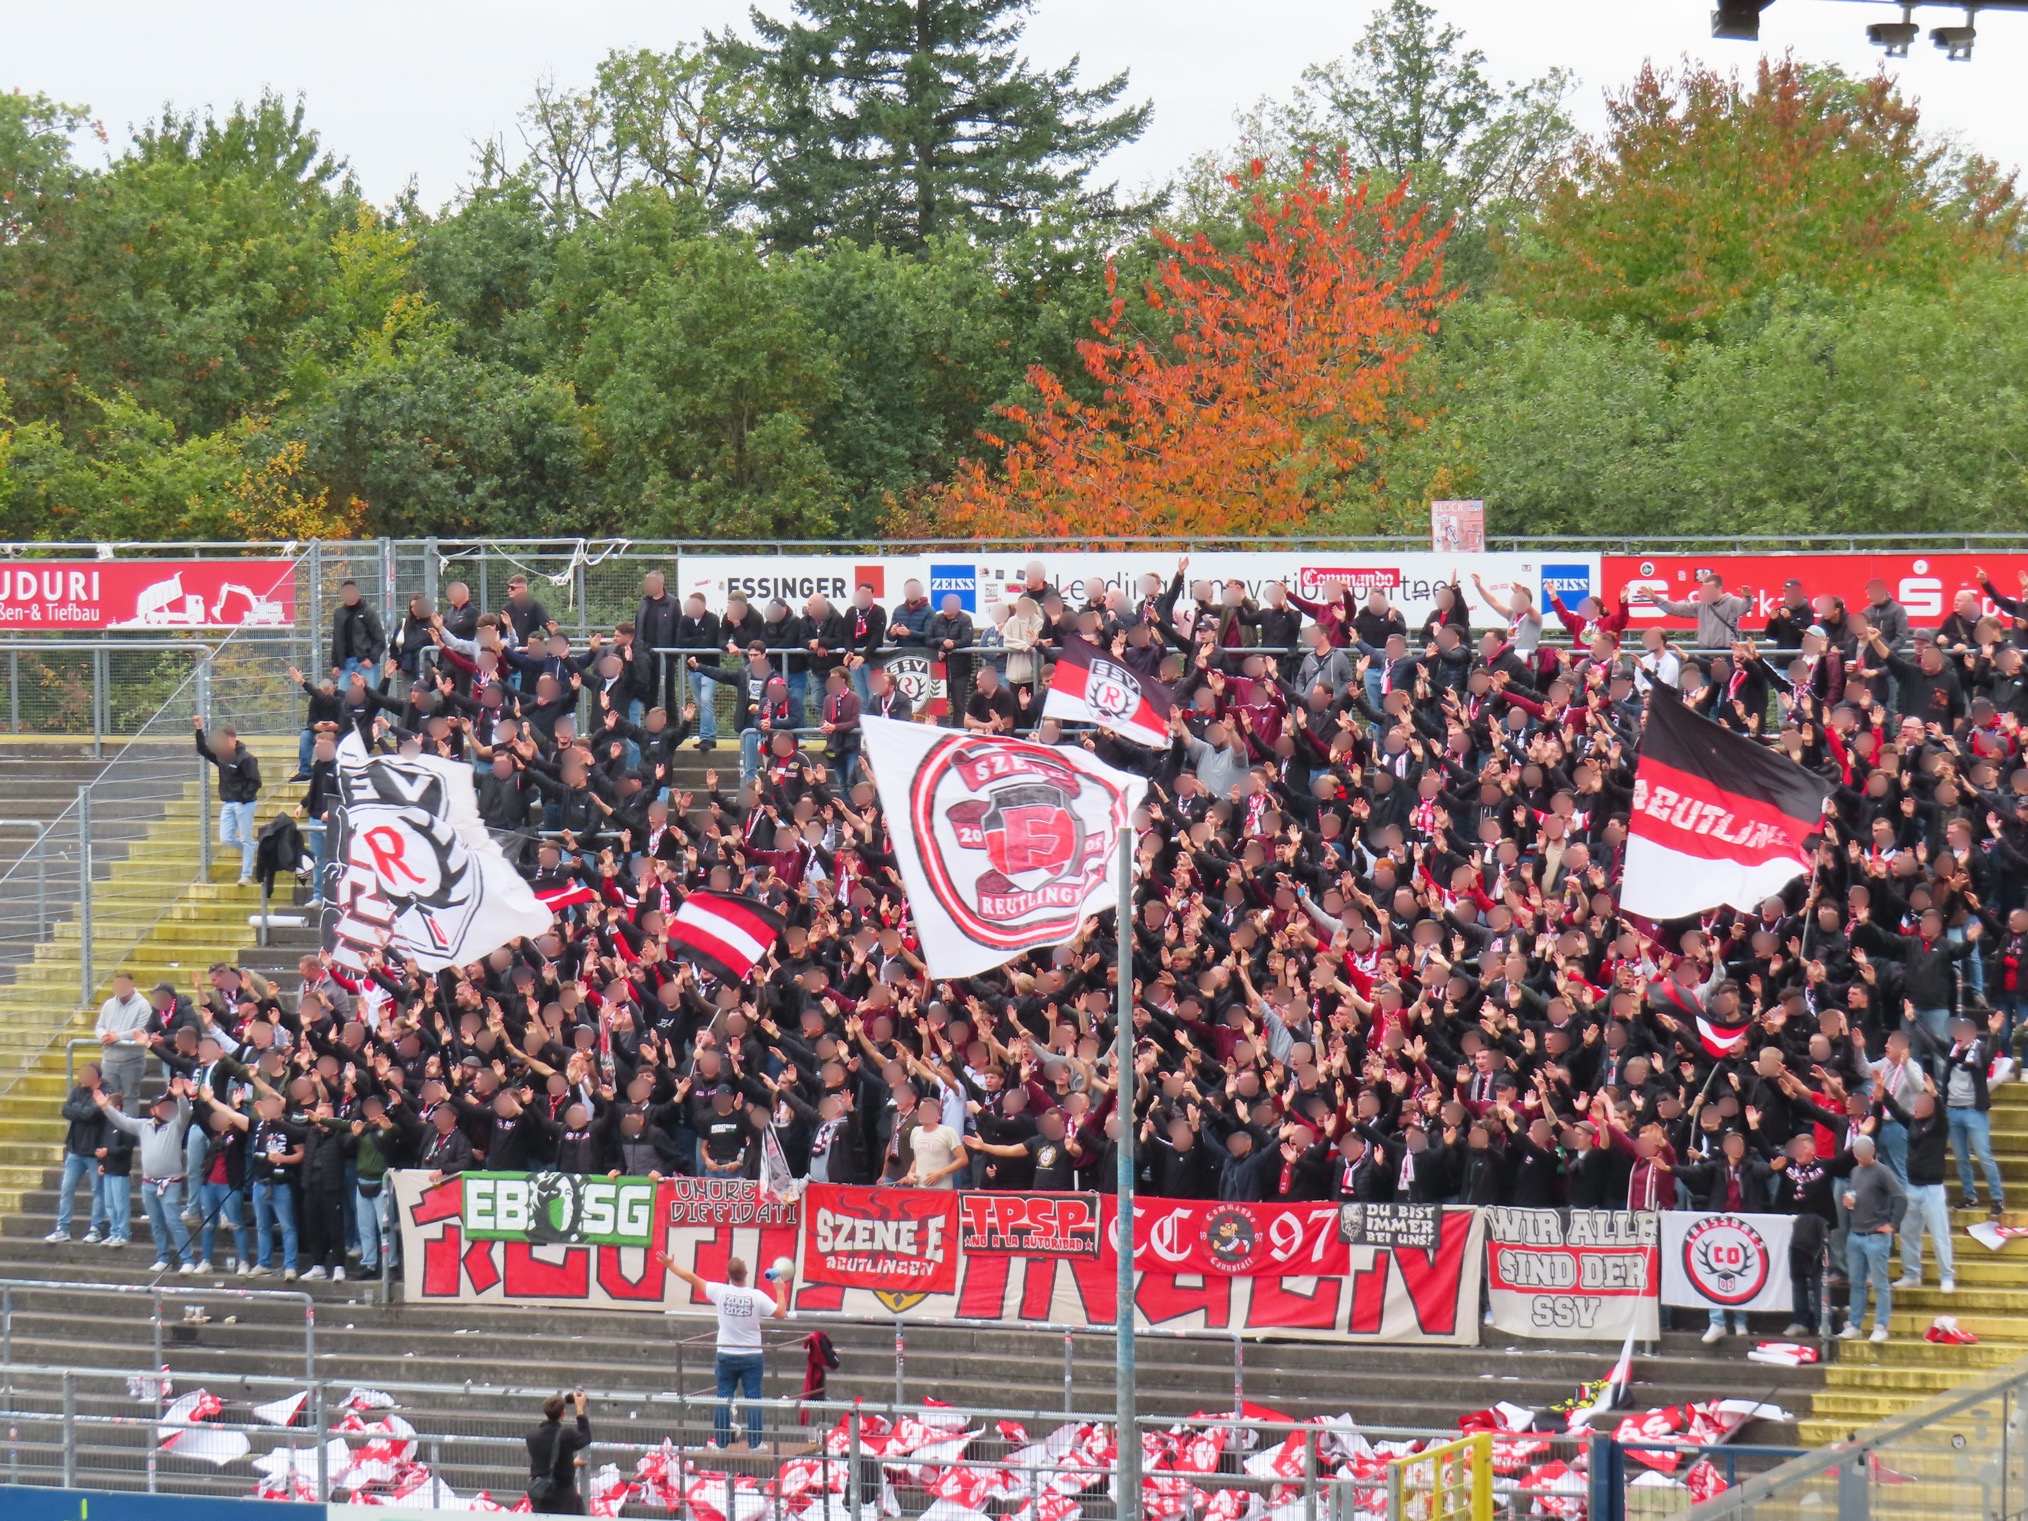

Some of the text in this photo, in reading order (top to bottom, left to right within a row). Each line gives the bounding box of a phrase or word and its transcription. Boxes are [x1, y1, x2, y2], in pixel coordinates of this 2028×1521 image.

[1432, 503, 1464, 513] BLOCK
[932, 578, 975, 591] ZEISS
[1302, 568, 1394, 588] Commando
[727, 577, 846, 599] ESSINGER
[45, 603, 100, 621] Tiefbau
[890, 659, 926, 676] SSV
[1093, 660, 1137, 689] SSV
[1102, 685, 1120, 709] R
[958, 827, 982, 843] 20
[363, 825, 427, 888] R
[675, 1179, 756, 1201] ONORE
[670, 1200, 798, 1224] DIFFIDATI
[963, 1196, 1089, 1239] TPSP
[1205, 1203, 1256, 1222] Commando
[1366, 1203, 1435, 1219] DU BIST
[1108, 1204, 1339, 1263] CC 97
[1366, 1216, 1434, 1234] IMMER
[1487, 1205, 1561, 1245] WIR
[816, 1207, 946, 1263] SZENE E
[971, 1236, 1083, 1251] NO A LA AUTORIDAD
[1199, 1231, 1263, 1242] 19 97
[1366, 1231, 1435, 1246] BEI UNS!
[826, 1256, 935, 1276] REUTLINGEN
[1210, 1256, 1254, 1272] Cannstatt
[1499, 1250, 1646, 1289] SIND DER
[725, 1294, 753, 1306] 2005
[724, 1306, 752, 1316] 2025
[1531, 1295, 1601, 1328] SSV
